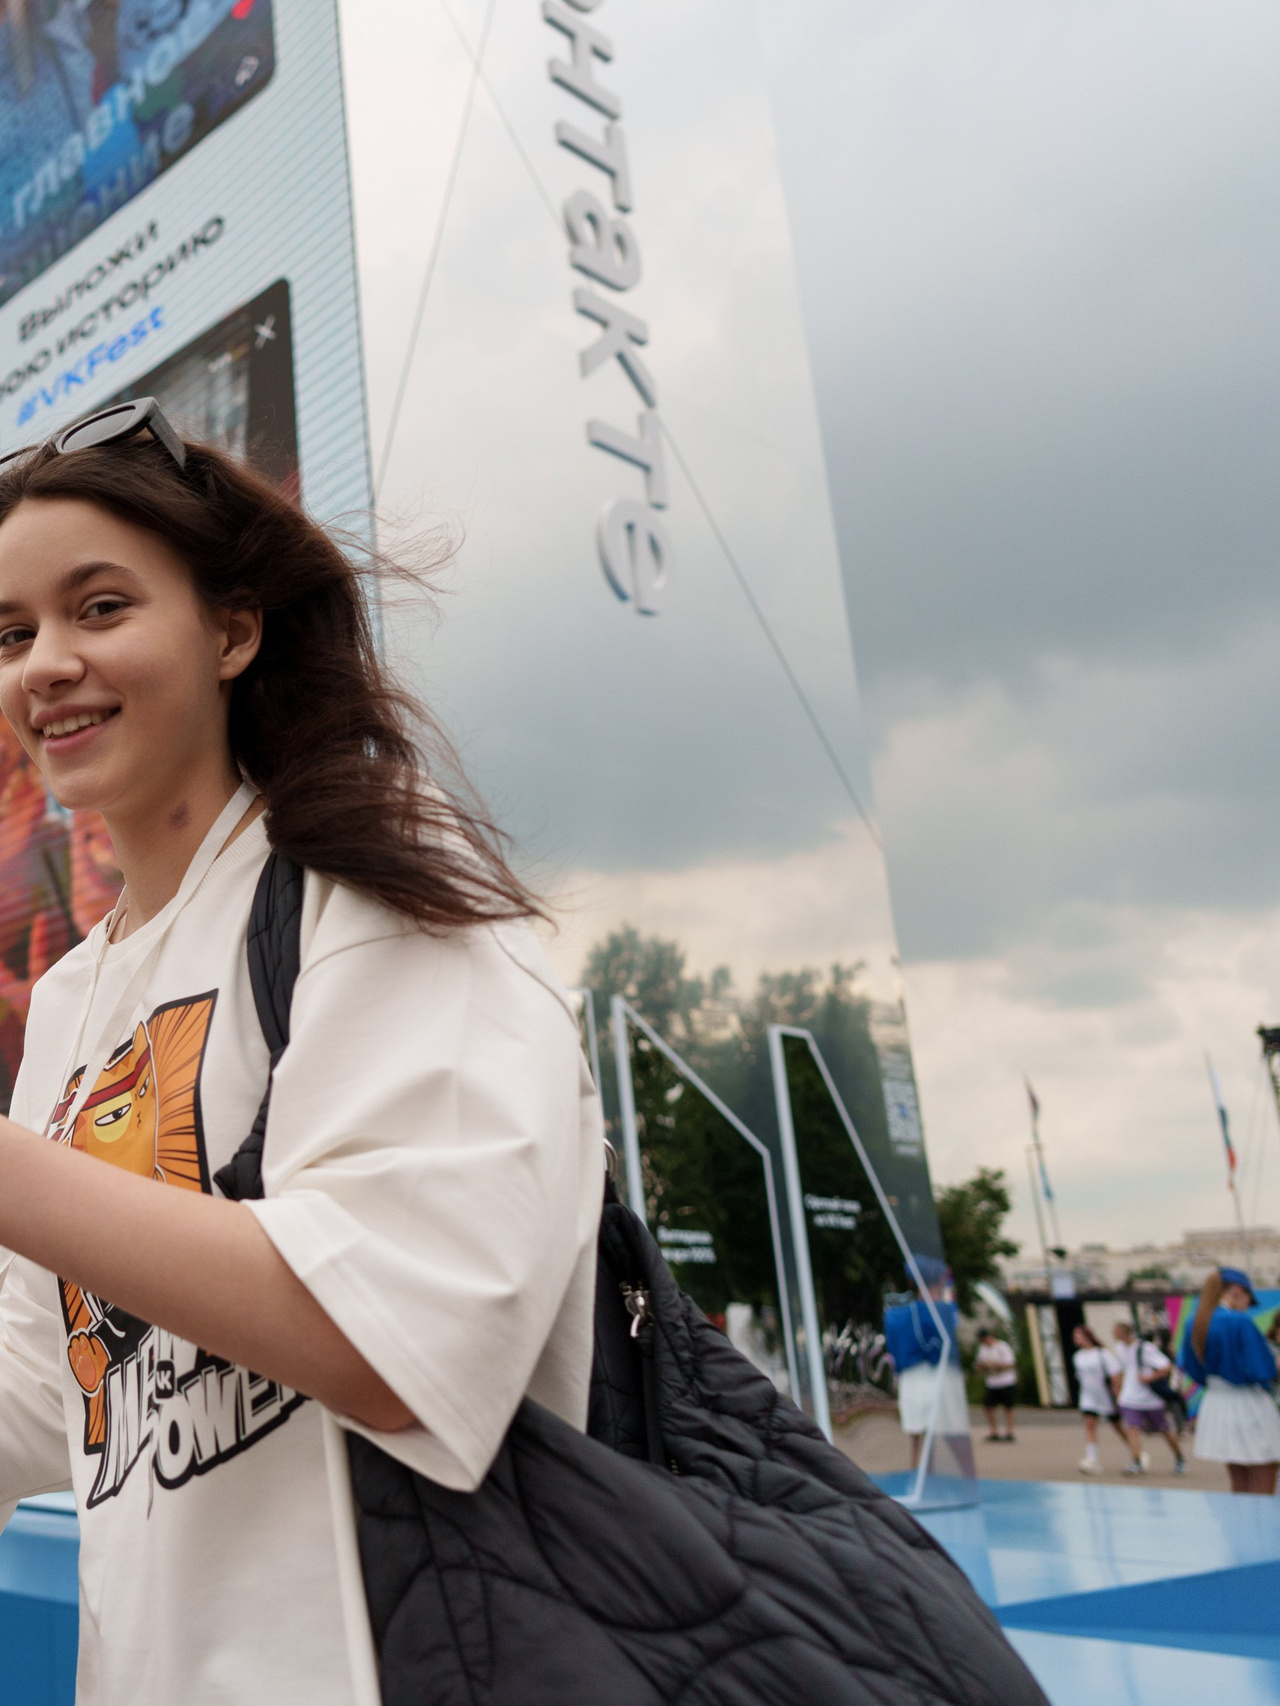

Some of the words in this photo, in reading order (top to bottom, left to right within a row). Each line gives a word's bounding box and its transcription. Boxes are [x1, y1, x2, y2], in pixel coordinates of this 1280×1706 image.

[17, 218, 159, 343] Выложи
[55, 215, 226, 356] историю
[540, 0, 670, 617] нтакте
